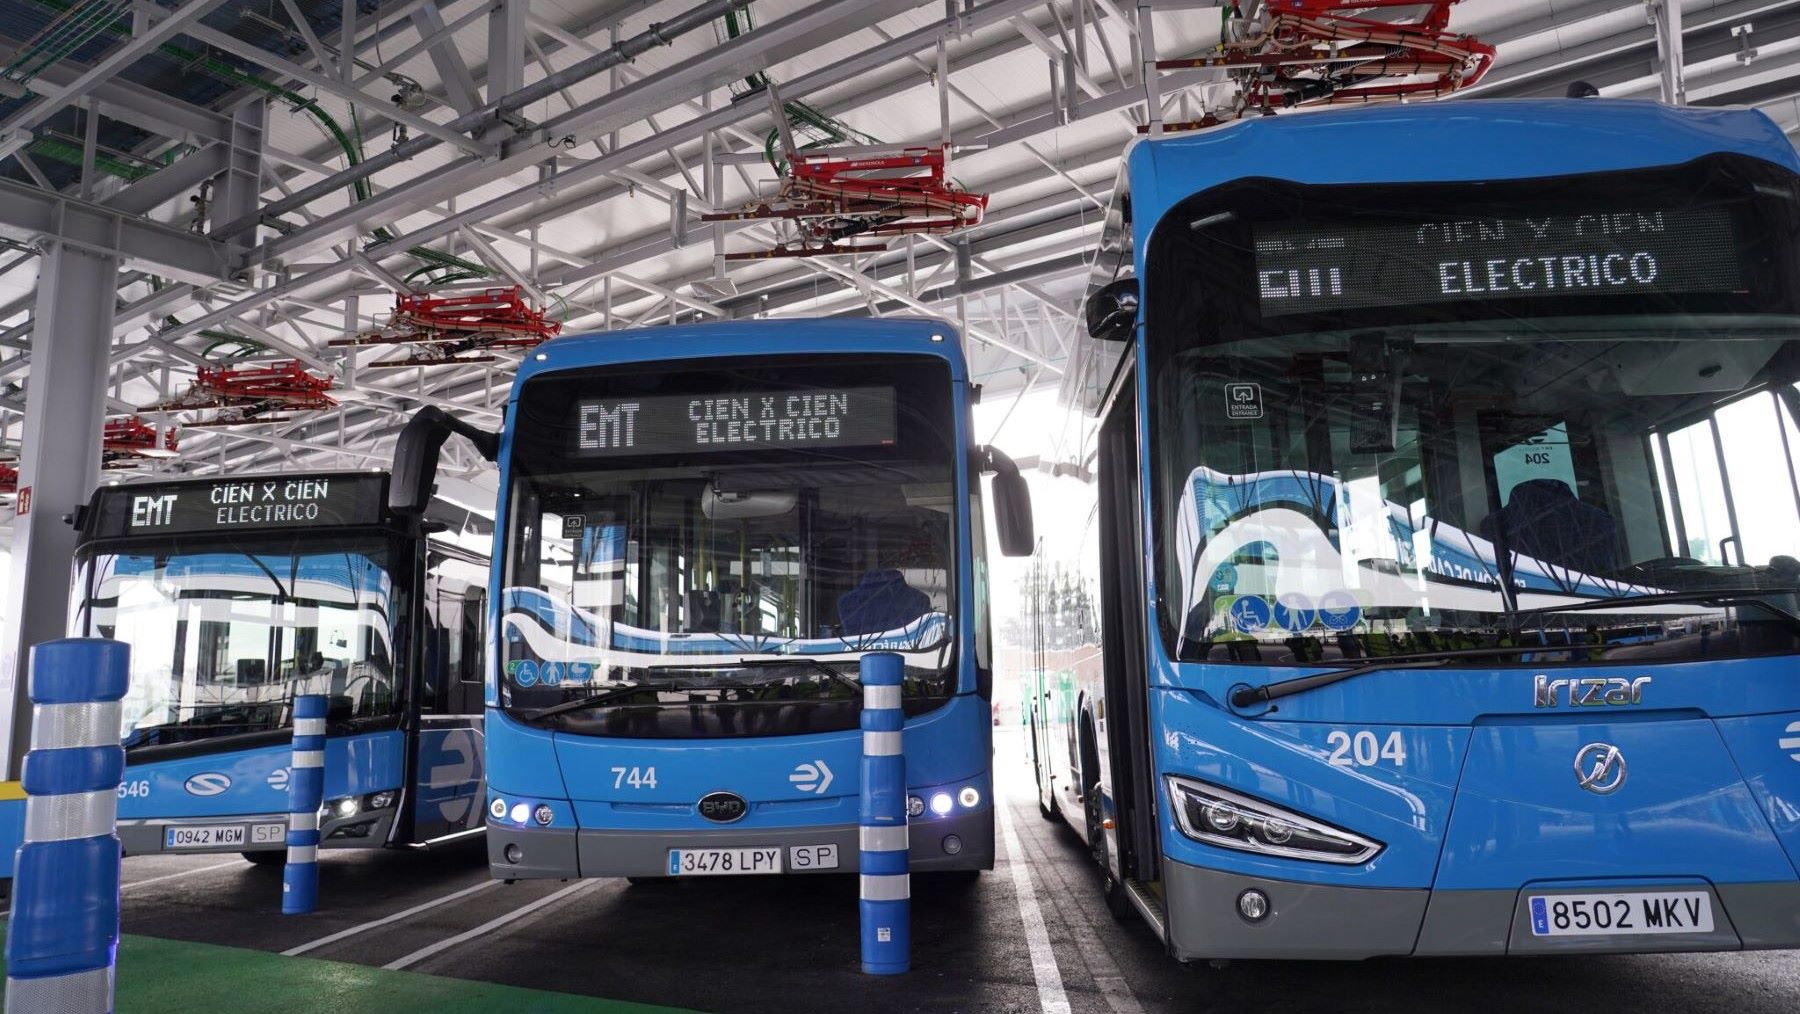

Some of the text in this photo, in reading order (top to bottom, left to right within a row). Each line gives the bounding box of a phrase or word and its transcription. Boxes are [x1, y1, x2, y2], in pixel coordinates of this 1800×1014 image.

[1438, 252, 1657, 294] ELECTRICO
[688, 393, 847, 421] CIEN X CIEN
[579, 403, 640, 449] EMT
[696, 417, 840, 444] ELECTRICO
[210, 479, 329, 504] CIEN X CIEN
[131, 494, 178, 527] EMT
[216, 503, 319, 524] ELECTRICO
[1326, 731, 1406, 767] 204
[117, 780, 150, 798] 546
[611, 766, 657, 789] 744
[702, 800, 742, 814] BYD
[176, 830, 209, 844] 0942
[215, 829, 243, 843] MGM
[256, 826, 281, 841] SP
[684, 852, 733, 871] 3478
[740, 851, 777, 870] LPY
[796, 847, 832, 867] SP
[1538, 897, 1700, 930] E 8502 MKV
